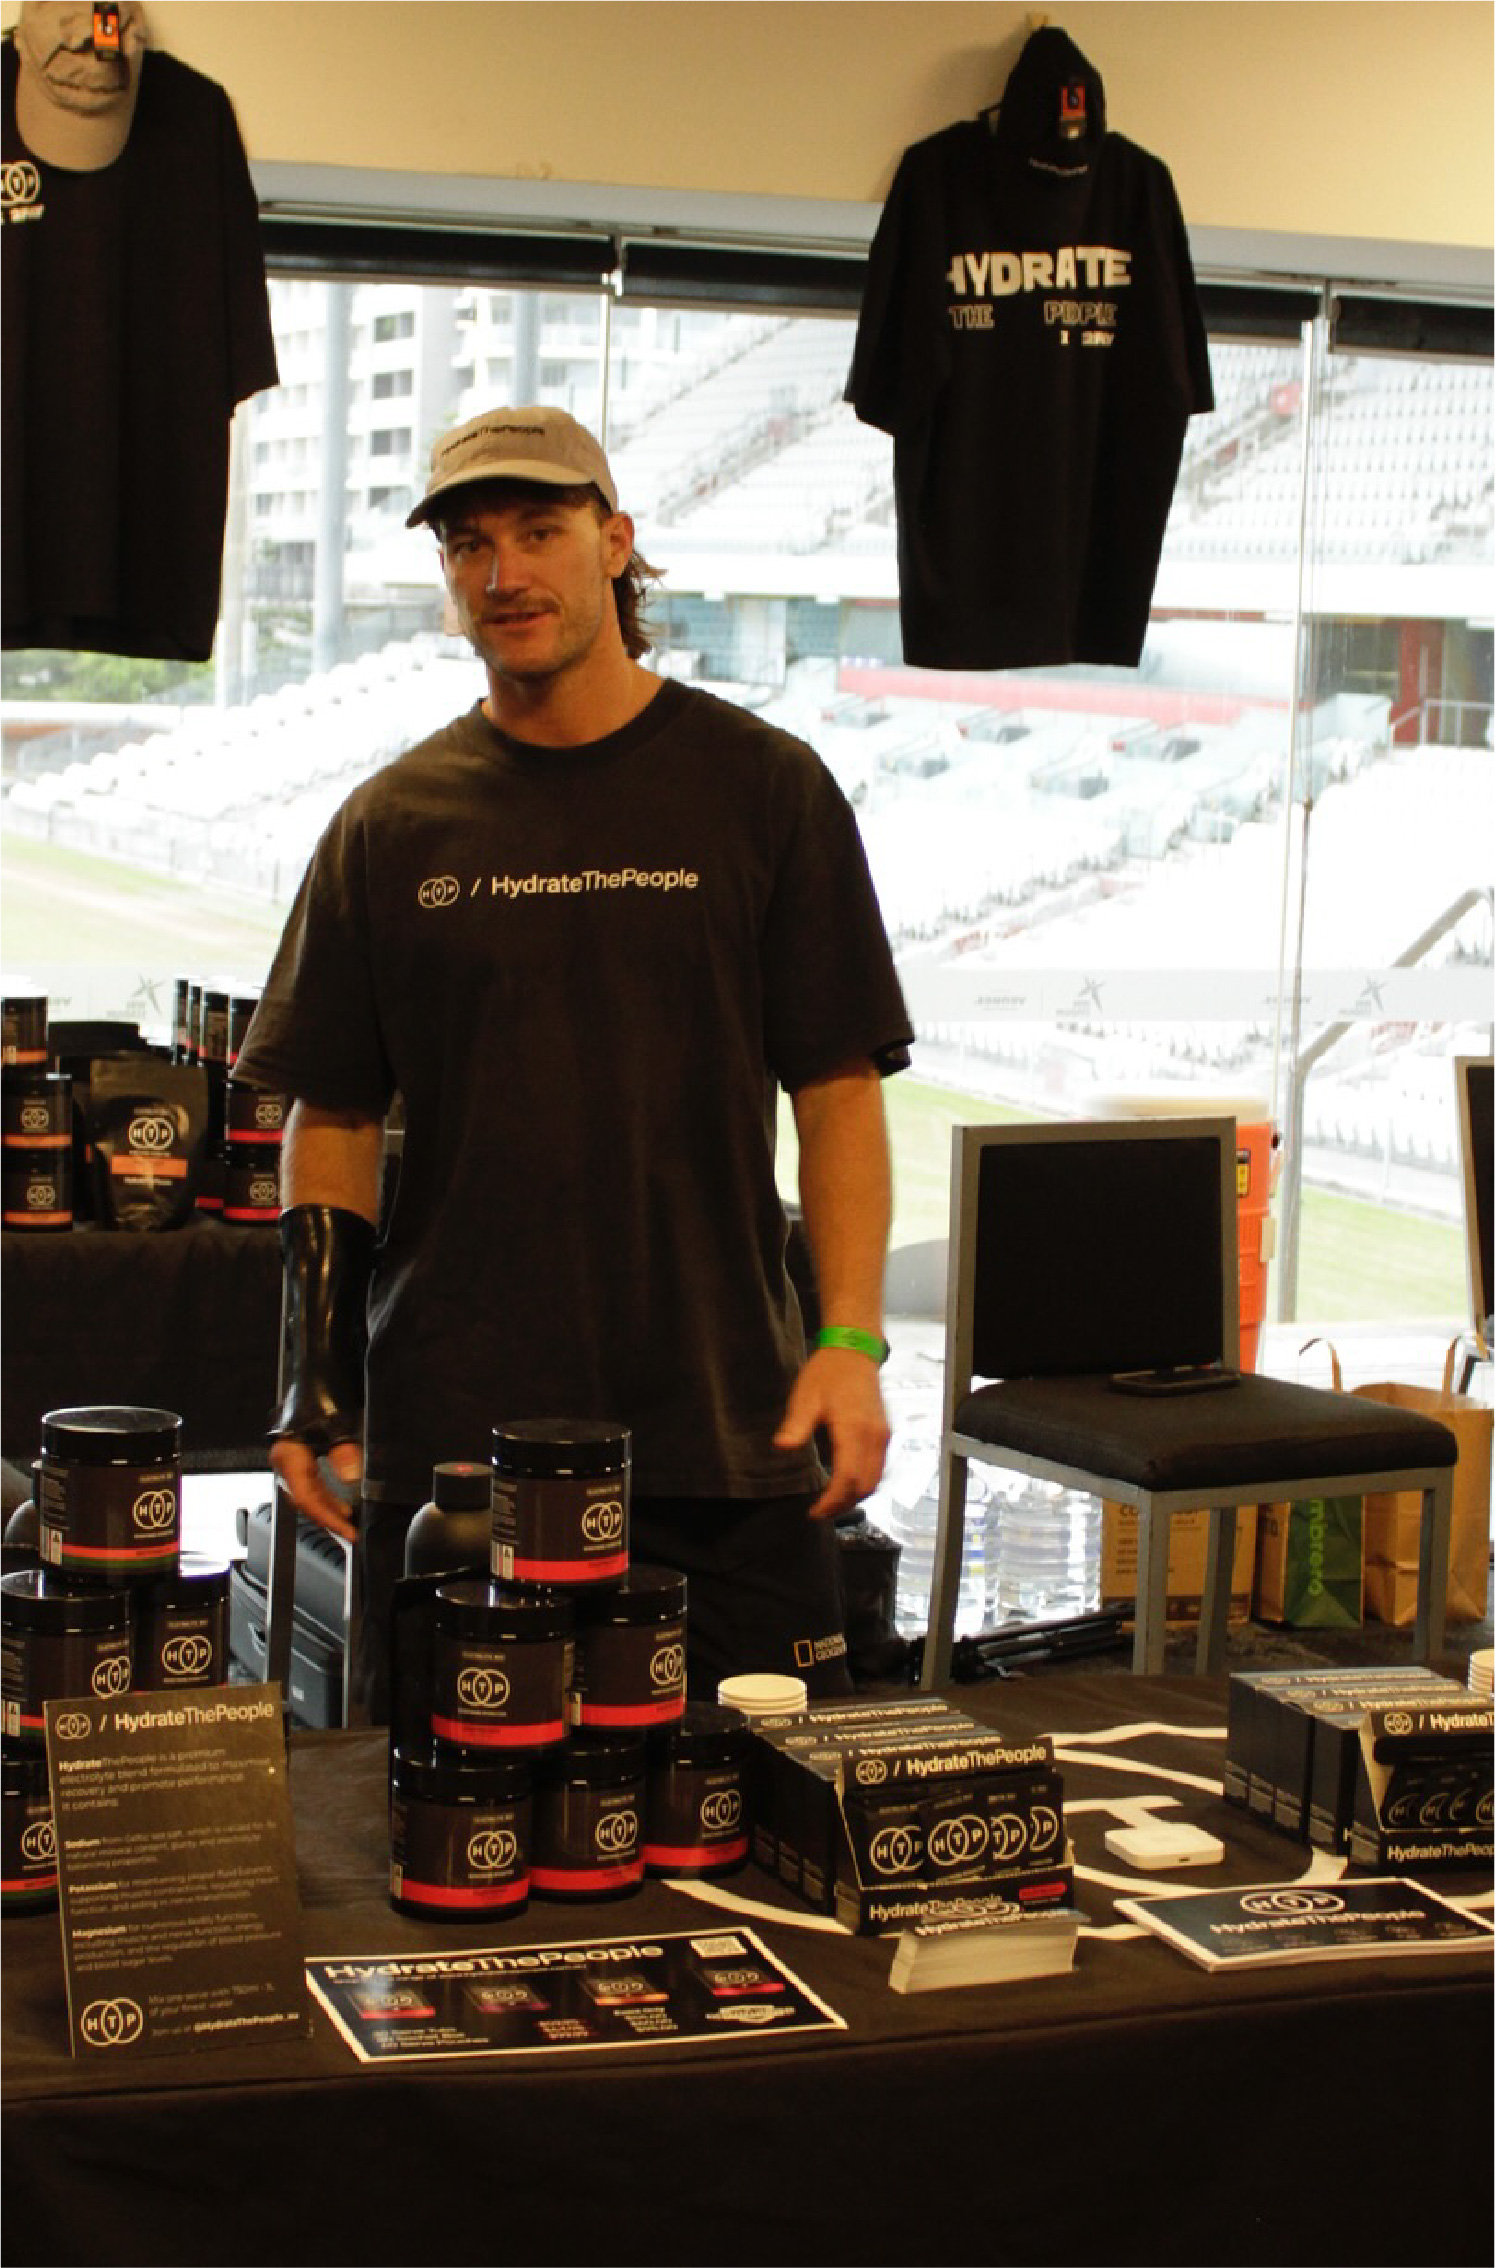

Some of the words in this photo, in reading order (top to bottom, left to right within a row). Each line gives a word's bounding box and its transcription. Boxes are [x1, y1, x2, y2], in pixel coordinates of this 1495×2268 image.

[946, 245, 1132, 297] HYDRATE
[491, 868, 699, 900] HydrateThePeople
[114, 1701, 275, 1733] HydrateThePeople
[907, 1745, 1046, 1777] HydrateThePeople
[325, 1943, 664, 1979] HydrateThePeople
